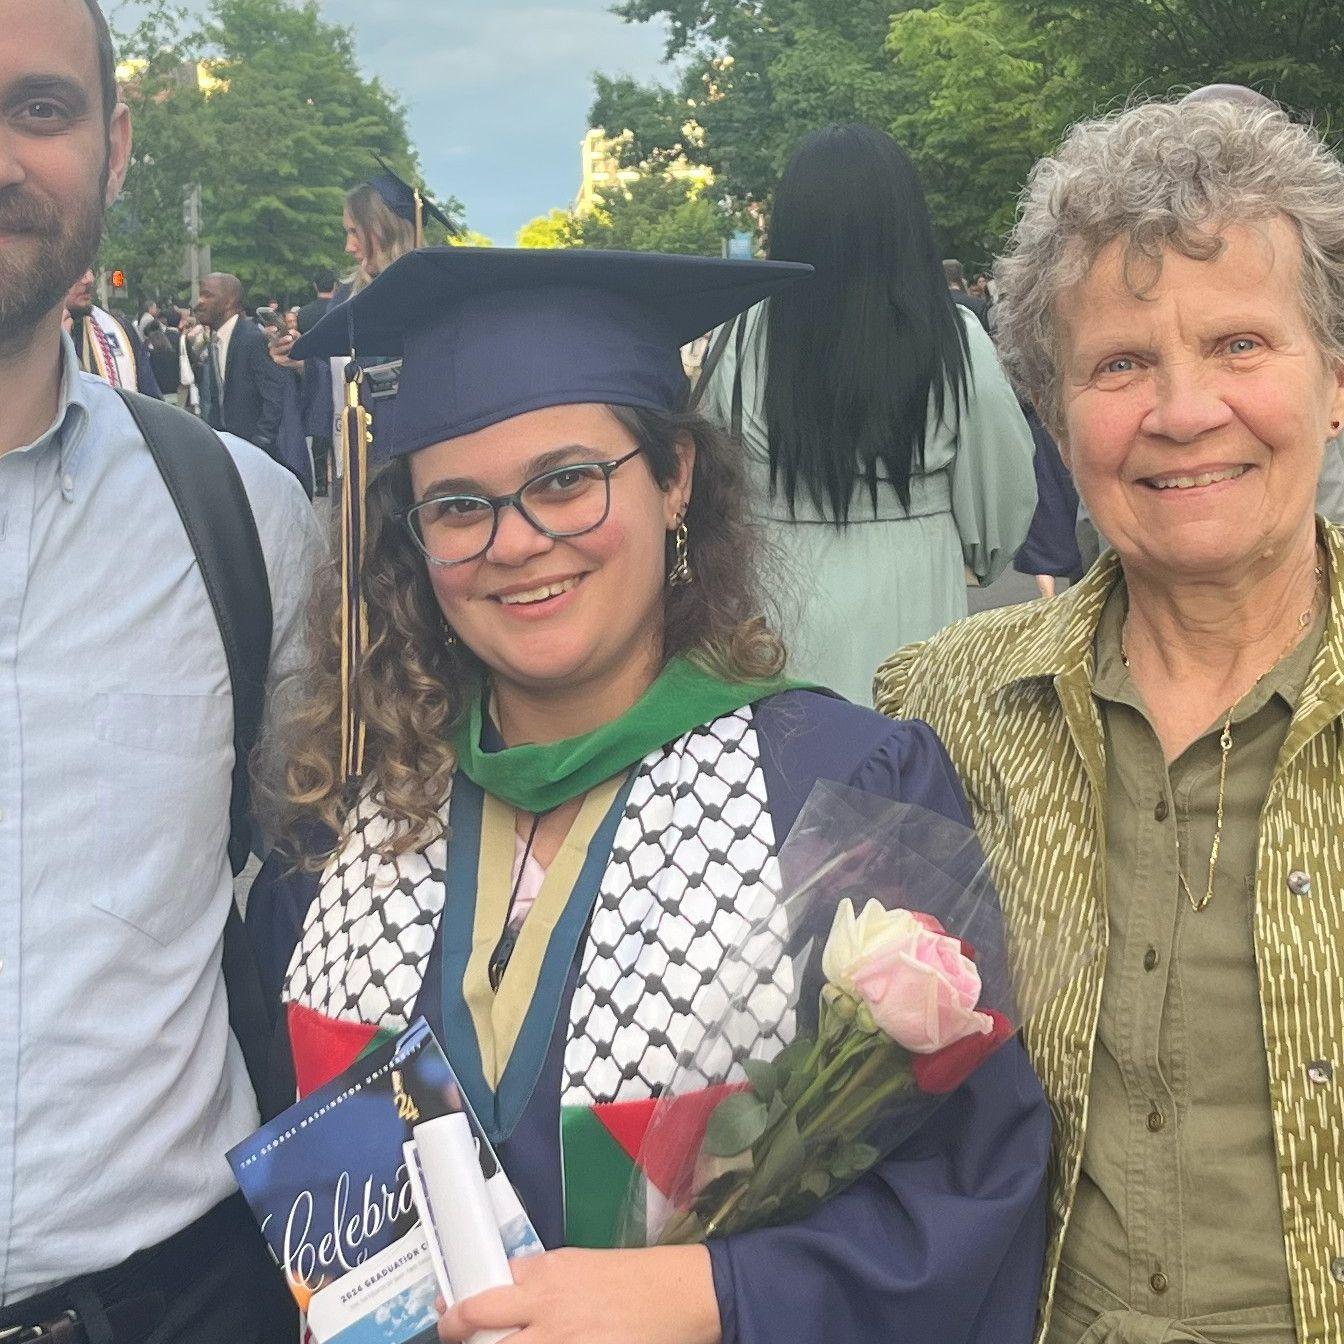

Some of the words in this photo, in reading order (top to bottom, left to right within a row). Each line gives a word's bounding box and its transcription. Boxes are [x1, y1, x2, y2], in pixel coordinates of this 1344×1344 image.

[240, 1154, 257, 1169] THE
[260, 1127, 297, 1156] GEORGE
[300, 1083, 362, 1128] WASHINGTON
[261, 1170, 416, 1293] Celebra
[364, 1247, 420, 1288] GRADUATION
